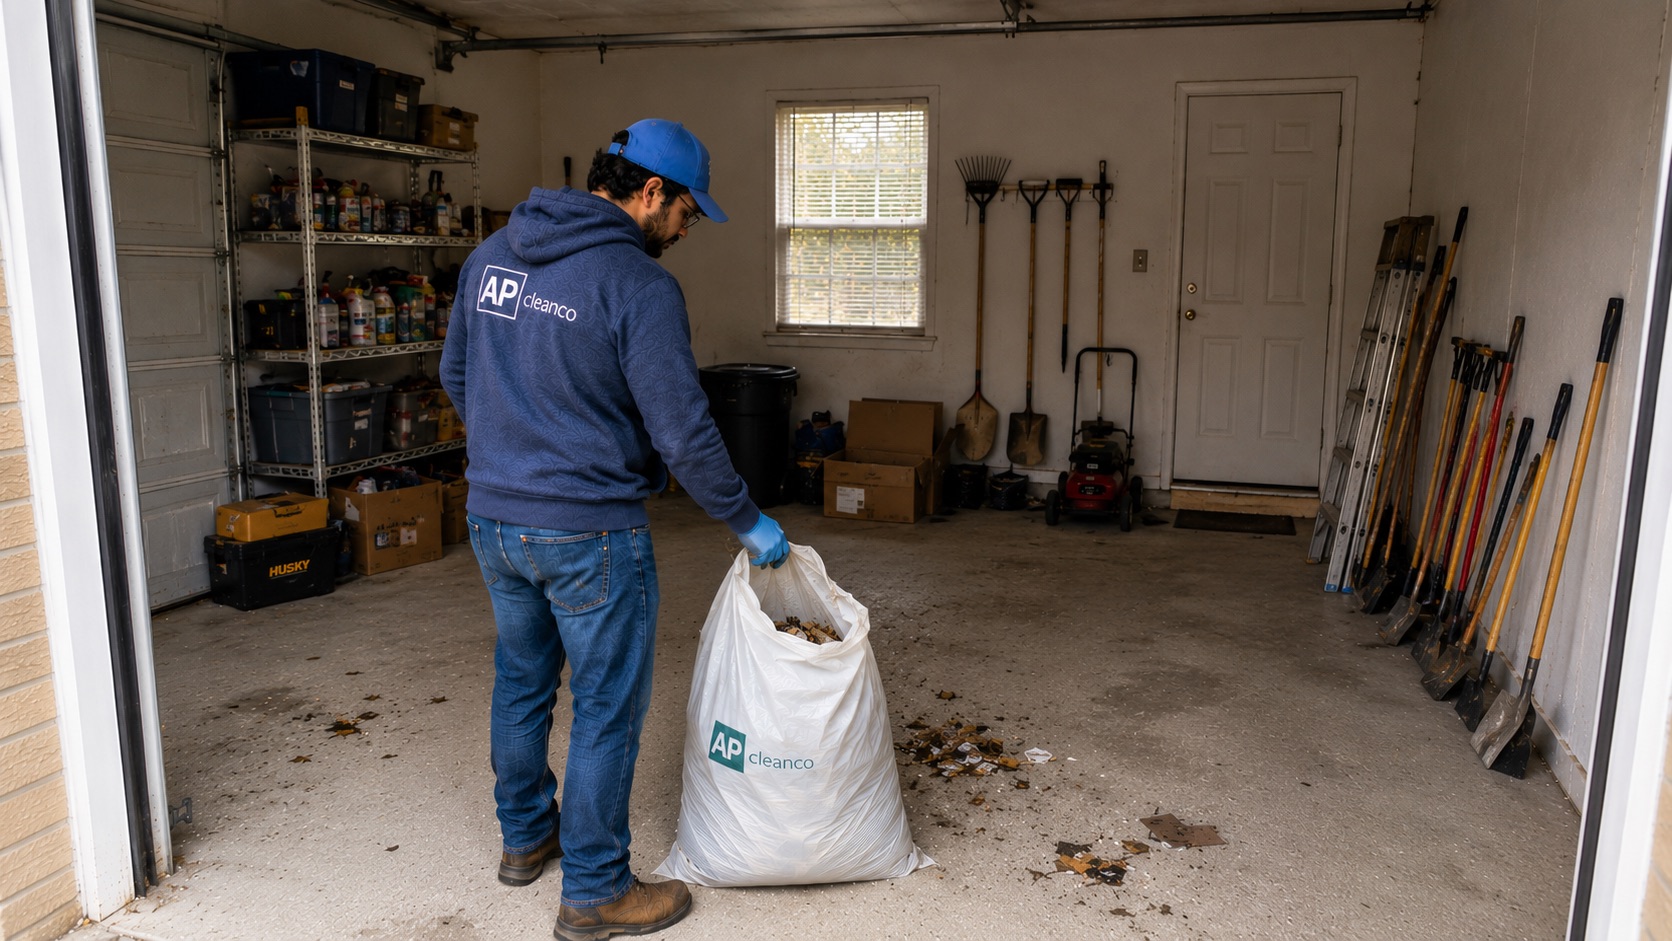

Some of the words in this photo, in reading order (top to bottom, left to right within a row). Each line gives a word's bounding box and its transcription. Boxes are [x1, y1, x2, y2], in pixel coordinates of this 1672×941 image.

[480, 275, 519, 307] AP
[523, 292, 577, 321] cleanco
[269, 560, 310, 577] HUSKY
[710, 731, 743, 760] AP
[748, 751, 814, 769] cleanco
